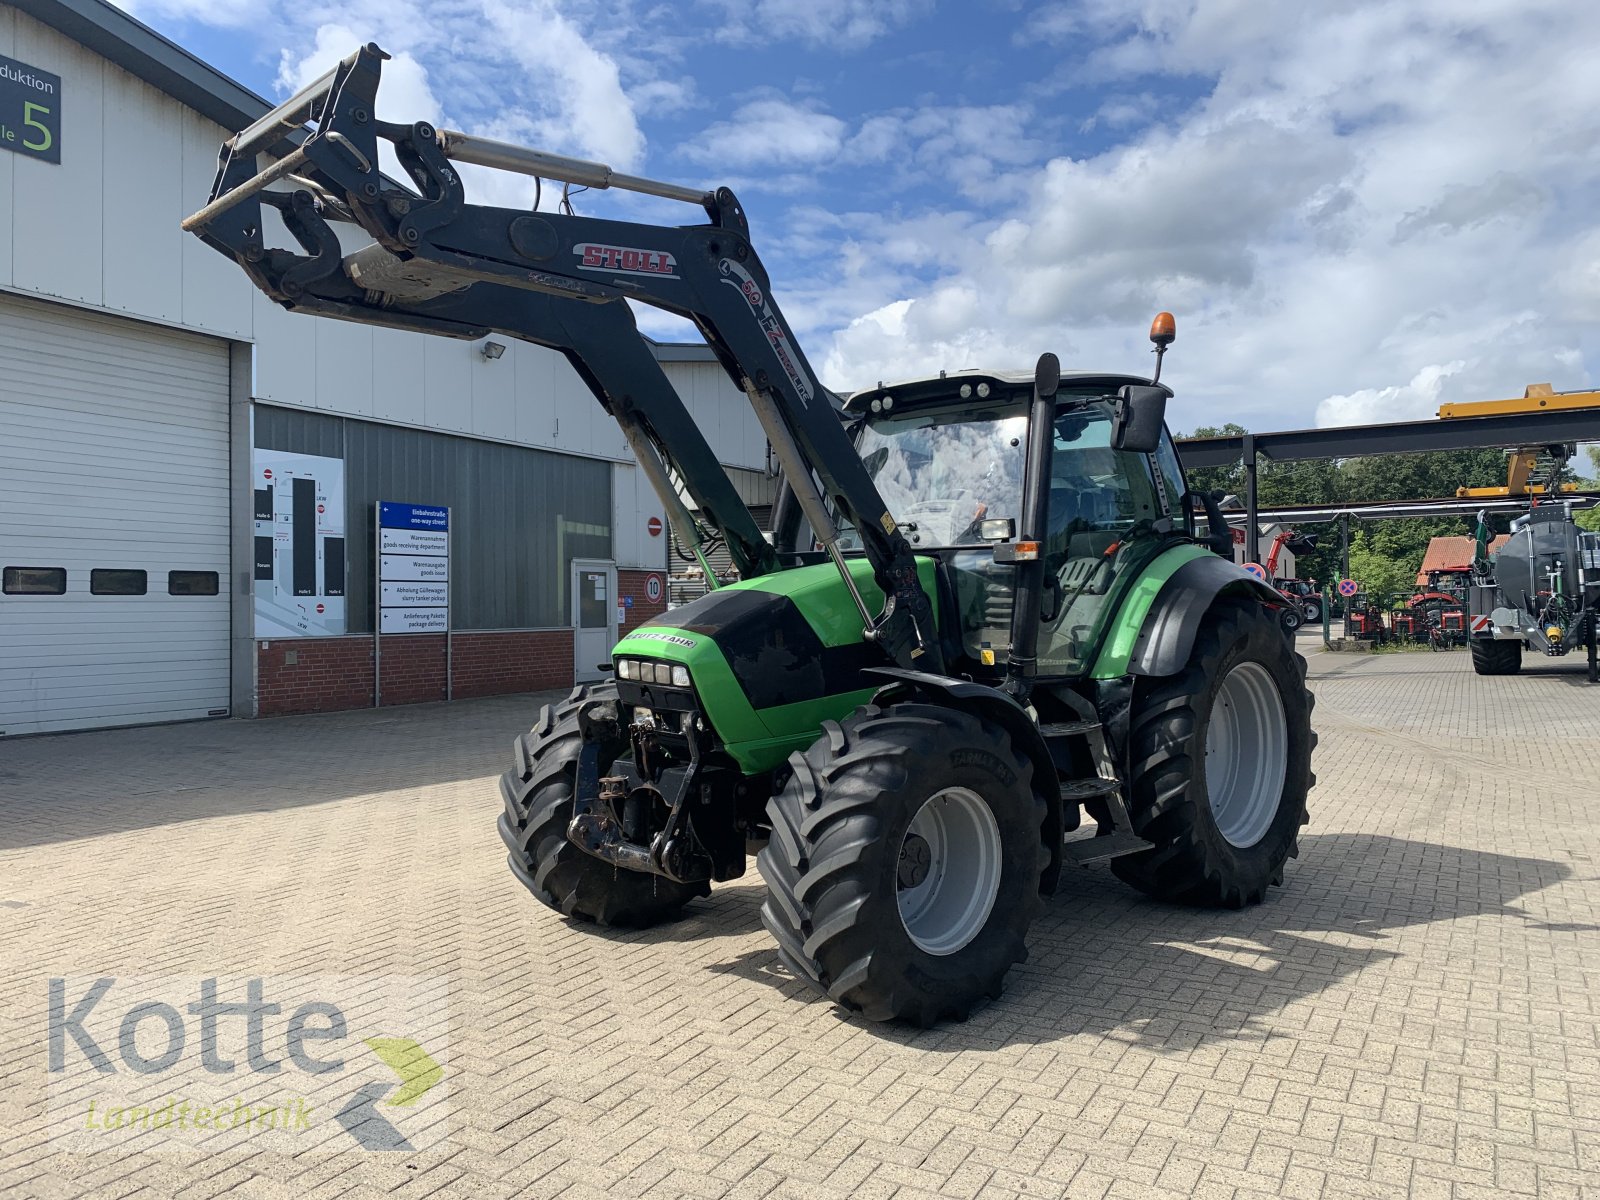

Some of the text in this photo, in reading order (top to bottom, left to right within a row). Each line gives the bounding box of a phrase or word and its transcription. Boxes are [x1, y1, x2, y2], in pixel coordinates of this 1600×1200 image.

[23, 101, 52, 151] 5
[582, 245, 673, 275] STOLL
[741, 280, 761, 305] 50
[761, 315, 785, 345] FZ
[412, 509, 446, 518] Einbahnstraße
[649, 582, 658, 595] 10
